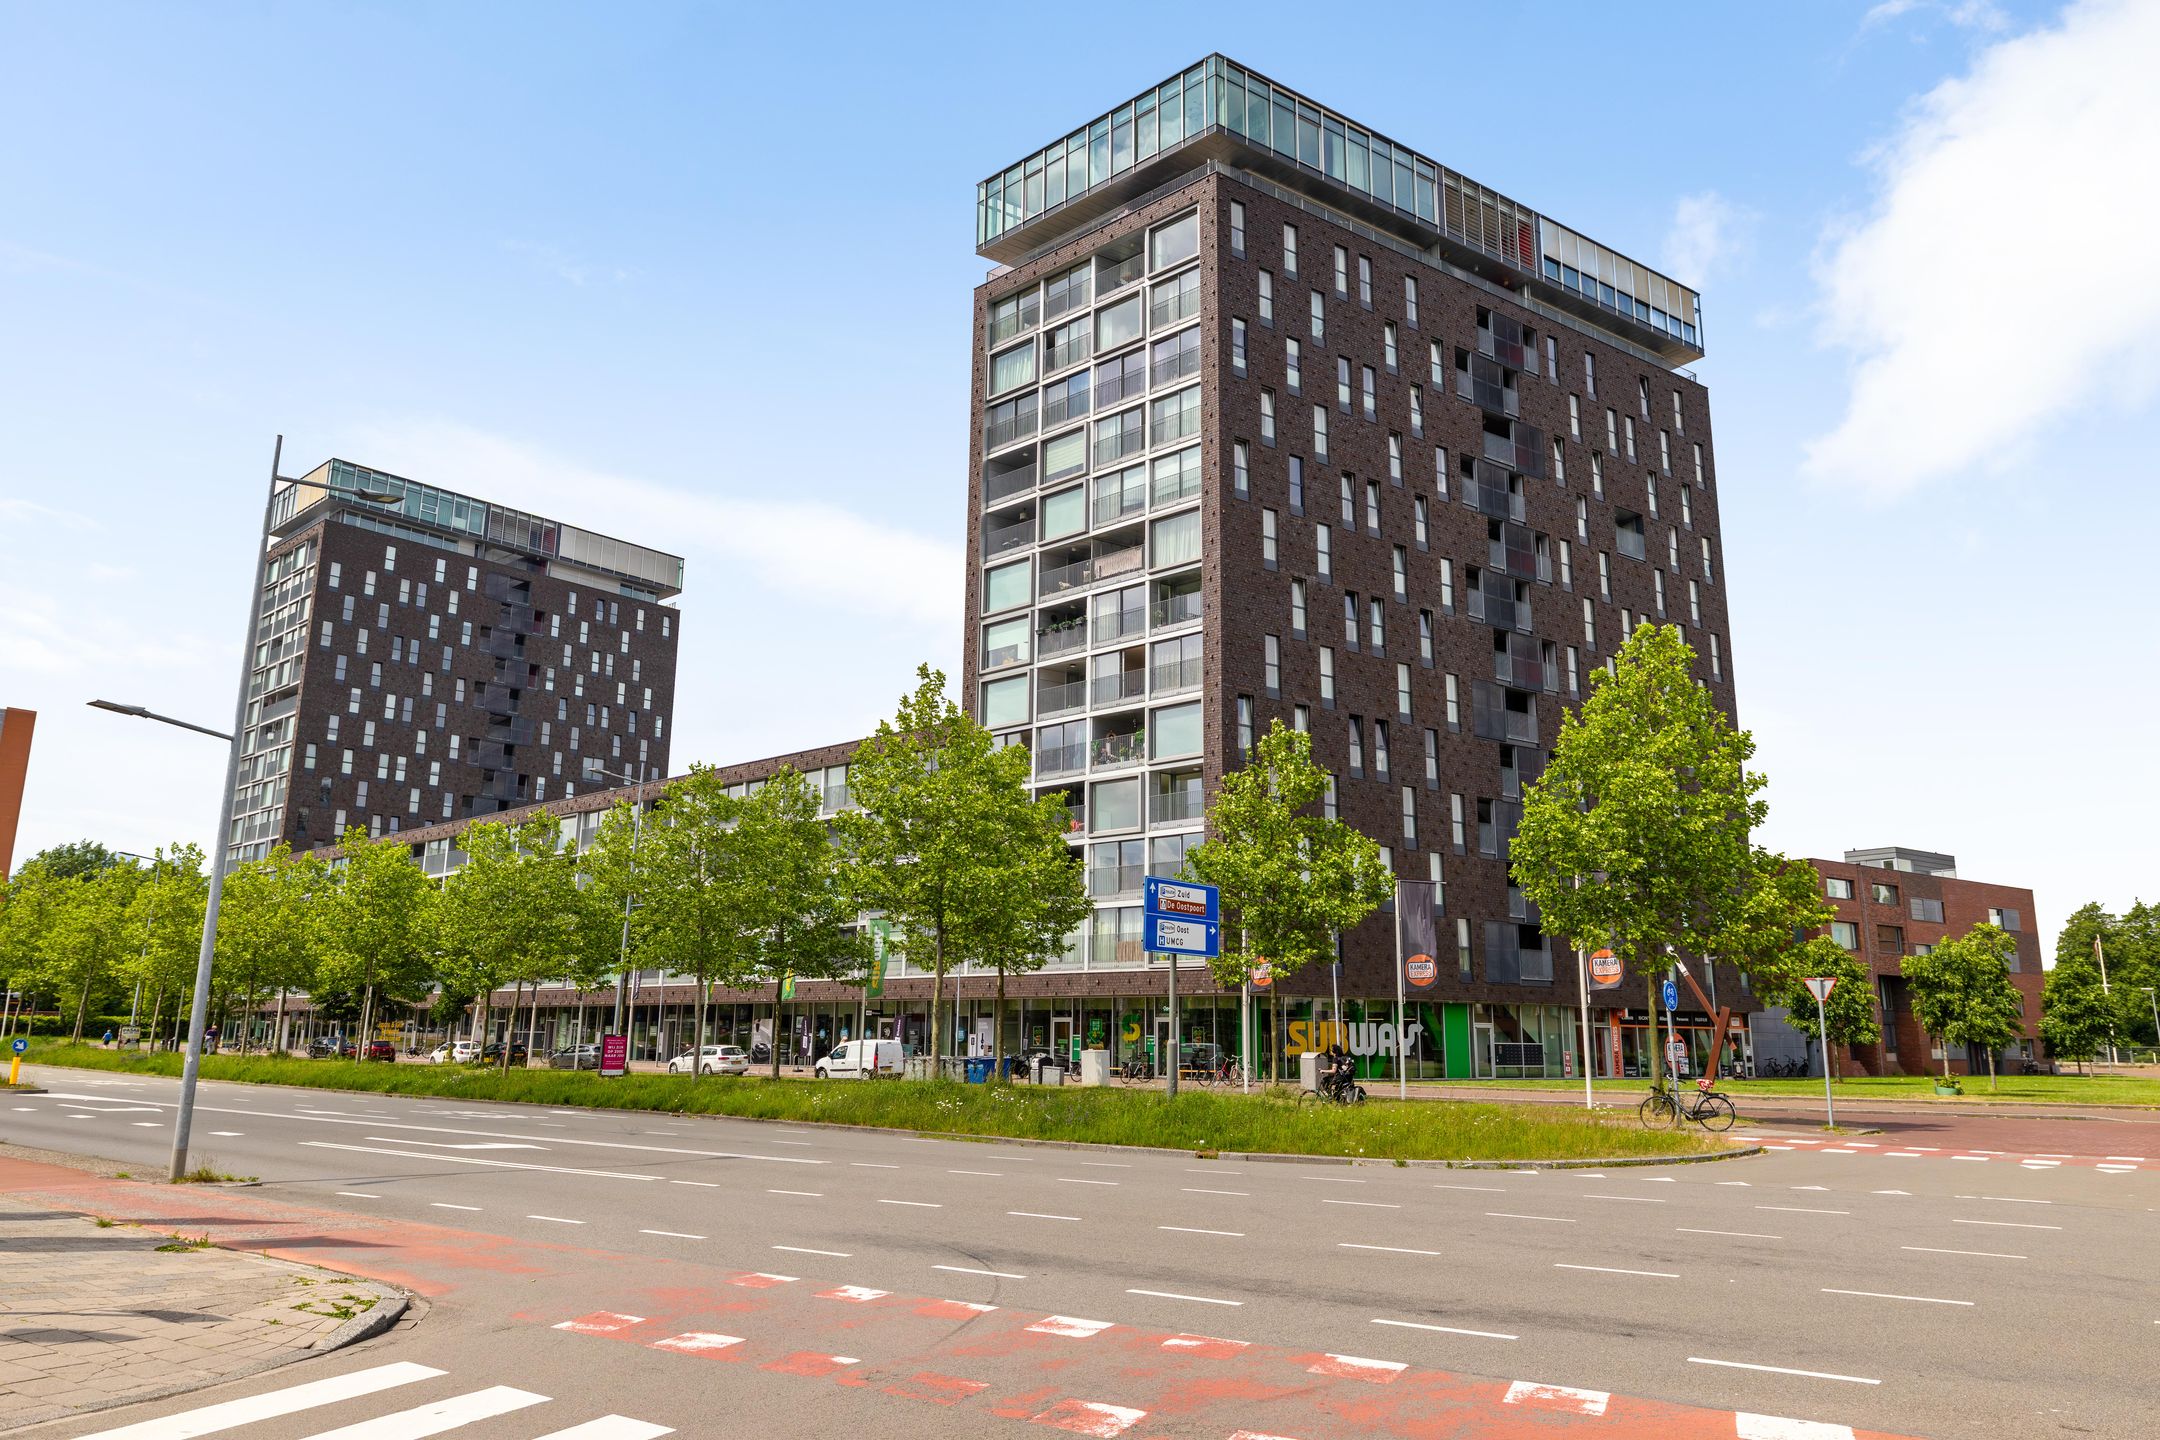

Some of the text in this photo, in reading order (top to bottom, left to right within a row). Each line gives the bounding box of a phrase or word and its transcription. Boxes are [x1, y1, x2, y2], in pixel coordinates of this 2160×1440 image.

[1177, 890, 1191, 899] Zuid
[1167, 900, 1205, 913] De Oostpoort
[1176, 925, 1190, 934] Oost
[1166, 938, 1184, 946] UMCG
[1409, 963, 1432, 971] KAMERA
[1594, 959, 1618, 967] KAMERA
[1286, 1021, 1424, 1057] SUBWAY
